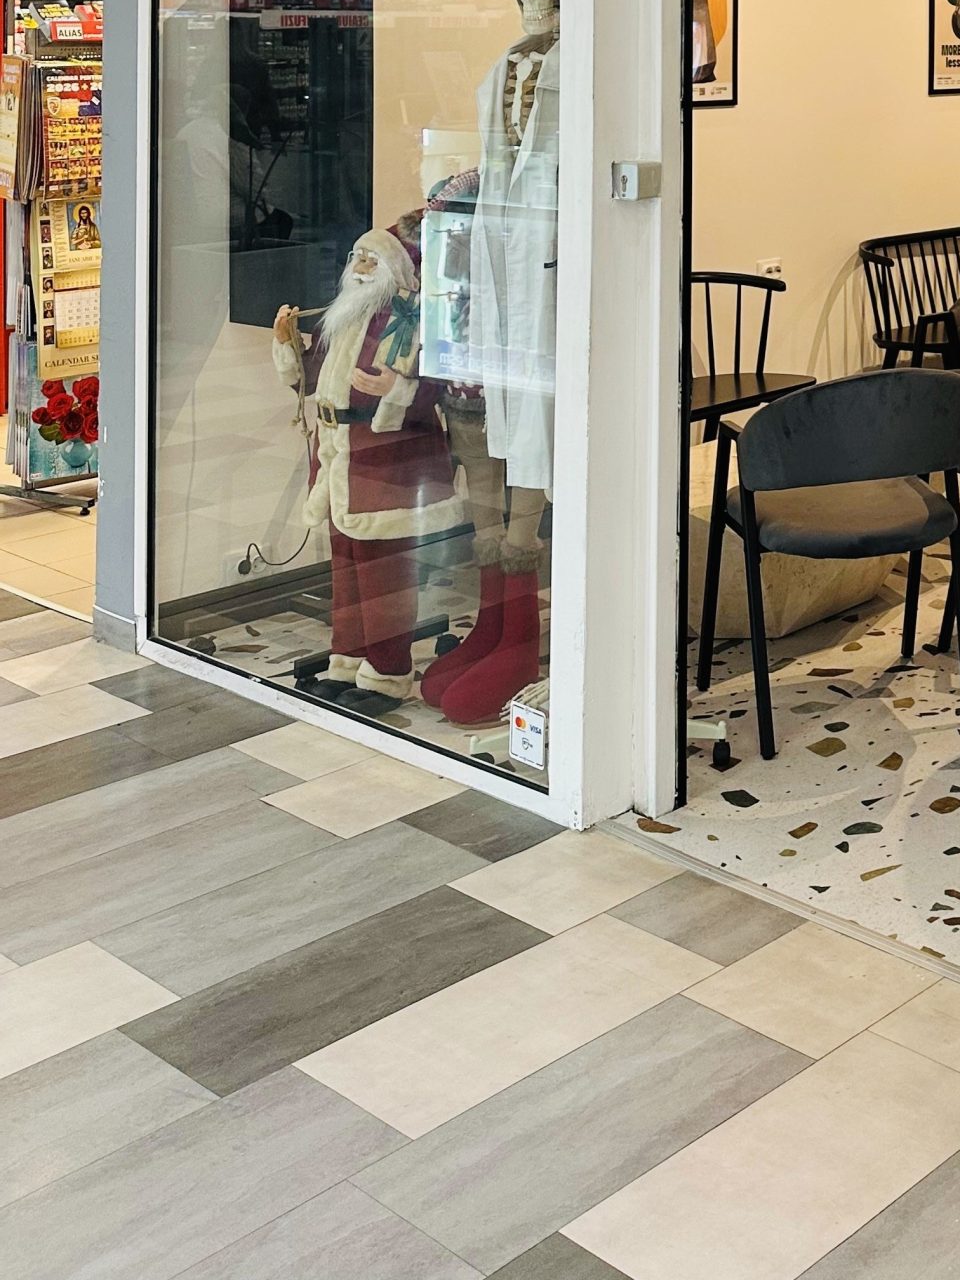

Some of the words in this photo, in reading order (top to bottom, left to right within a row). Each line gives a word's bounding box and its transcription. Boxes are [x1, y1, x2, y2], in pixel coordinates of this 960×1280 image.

[941, 45, 960, 55] MORE
[946, 57, 960, 67] less
[46, 83, 80, 92] 2026
[44, 355, 90, 368] CALENDAR
[530, 725, 541, 734] VISA
